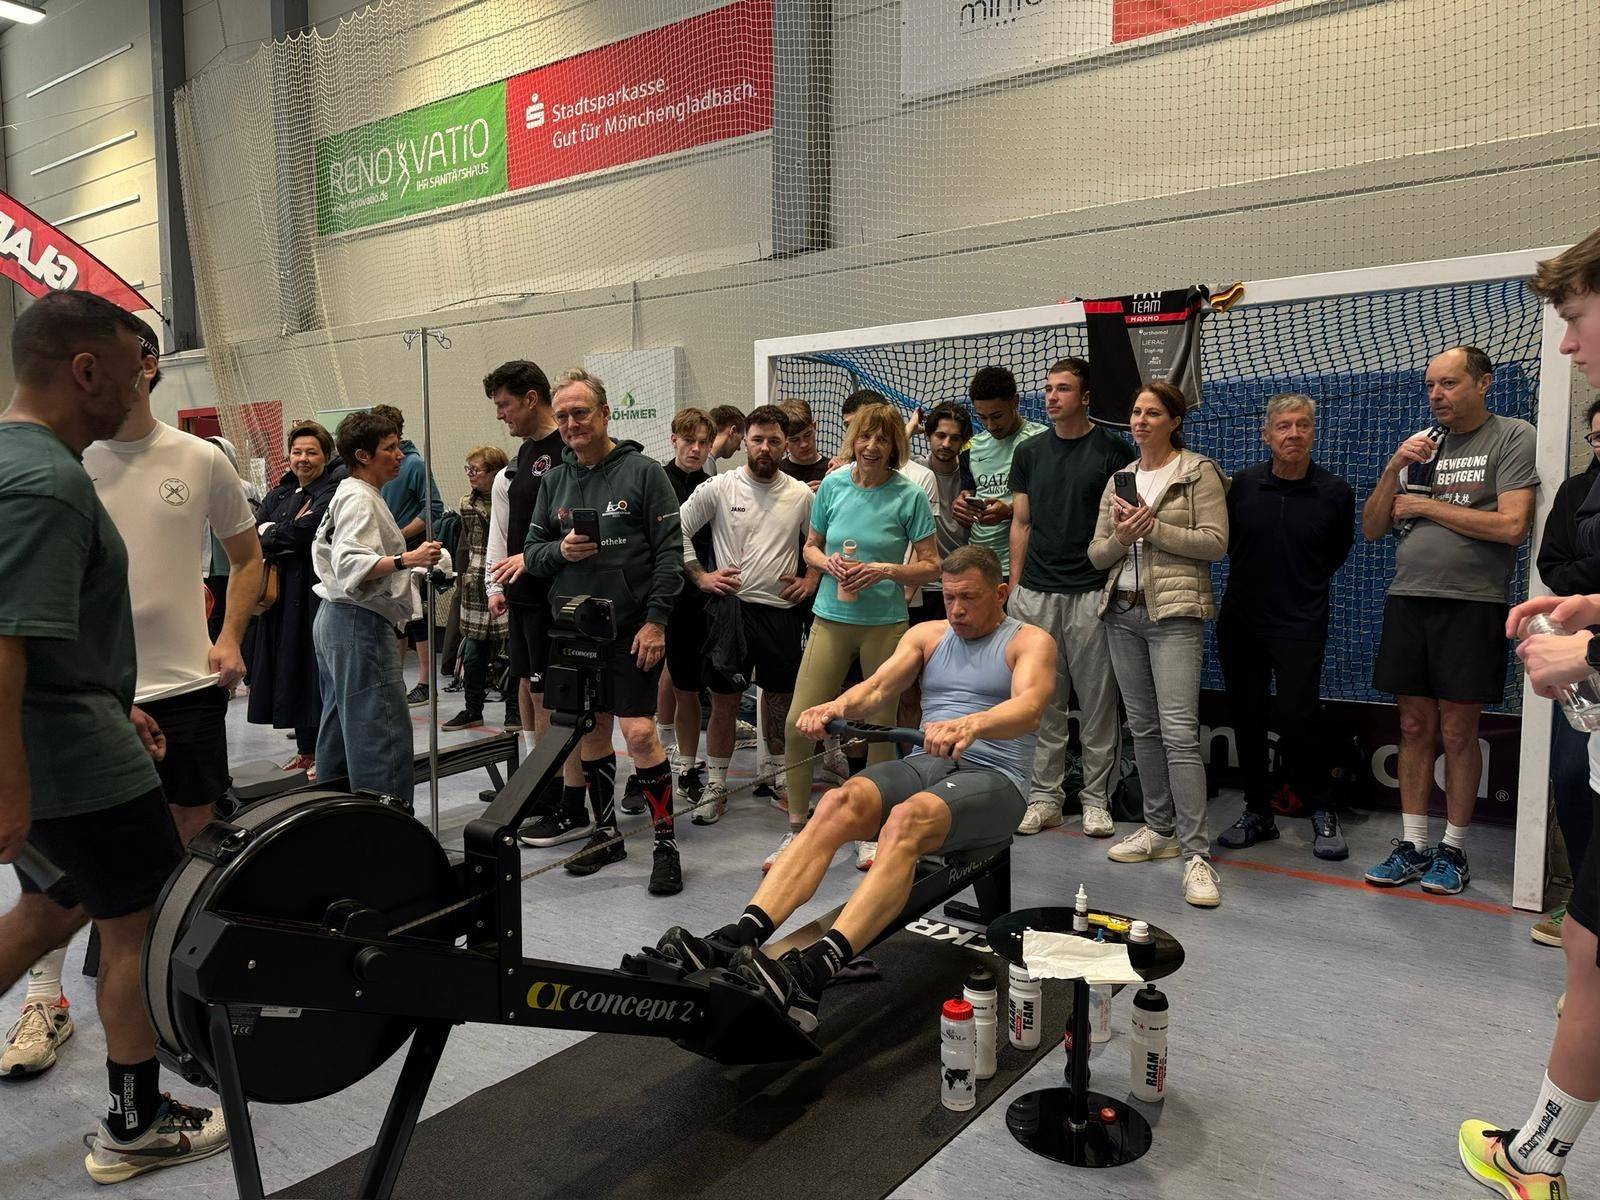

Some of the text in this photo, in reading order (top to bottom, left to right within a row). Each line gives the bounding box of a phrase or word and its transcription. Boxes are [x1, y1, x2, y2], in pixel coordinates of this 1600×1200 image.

[552, 77, 669, 123] Stadtsparkasse.
[553, 79, 758, 149] Gut für Mönchengladbach.
[416, 162, 489, 191] IHR SANITÄTSHAUS
[1132, 300, 1161, 313] TEAM
[608, 408, 657, 421] ÖHMER
[1436, 455, 1488, 470] BEWEGUNG
[600, 537, 627, 547] otheke
[569, 990, 695, 1022] concept 2
[1023, 1001, 1034, 1030] TEAM
[1146, 1051, 1159, 1087] RAAM
